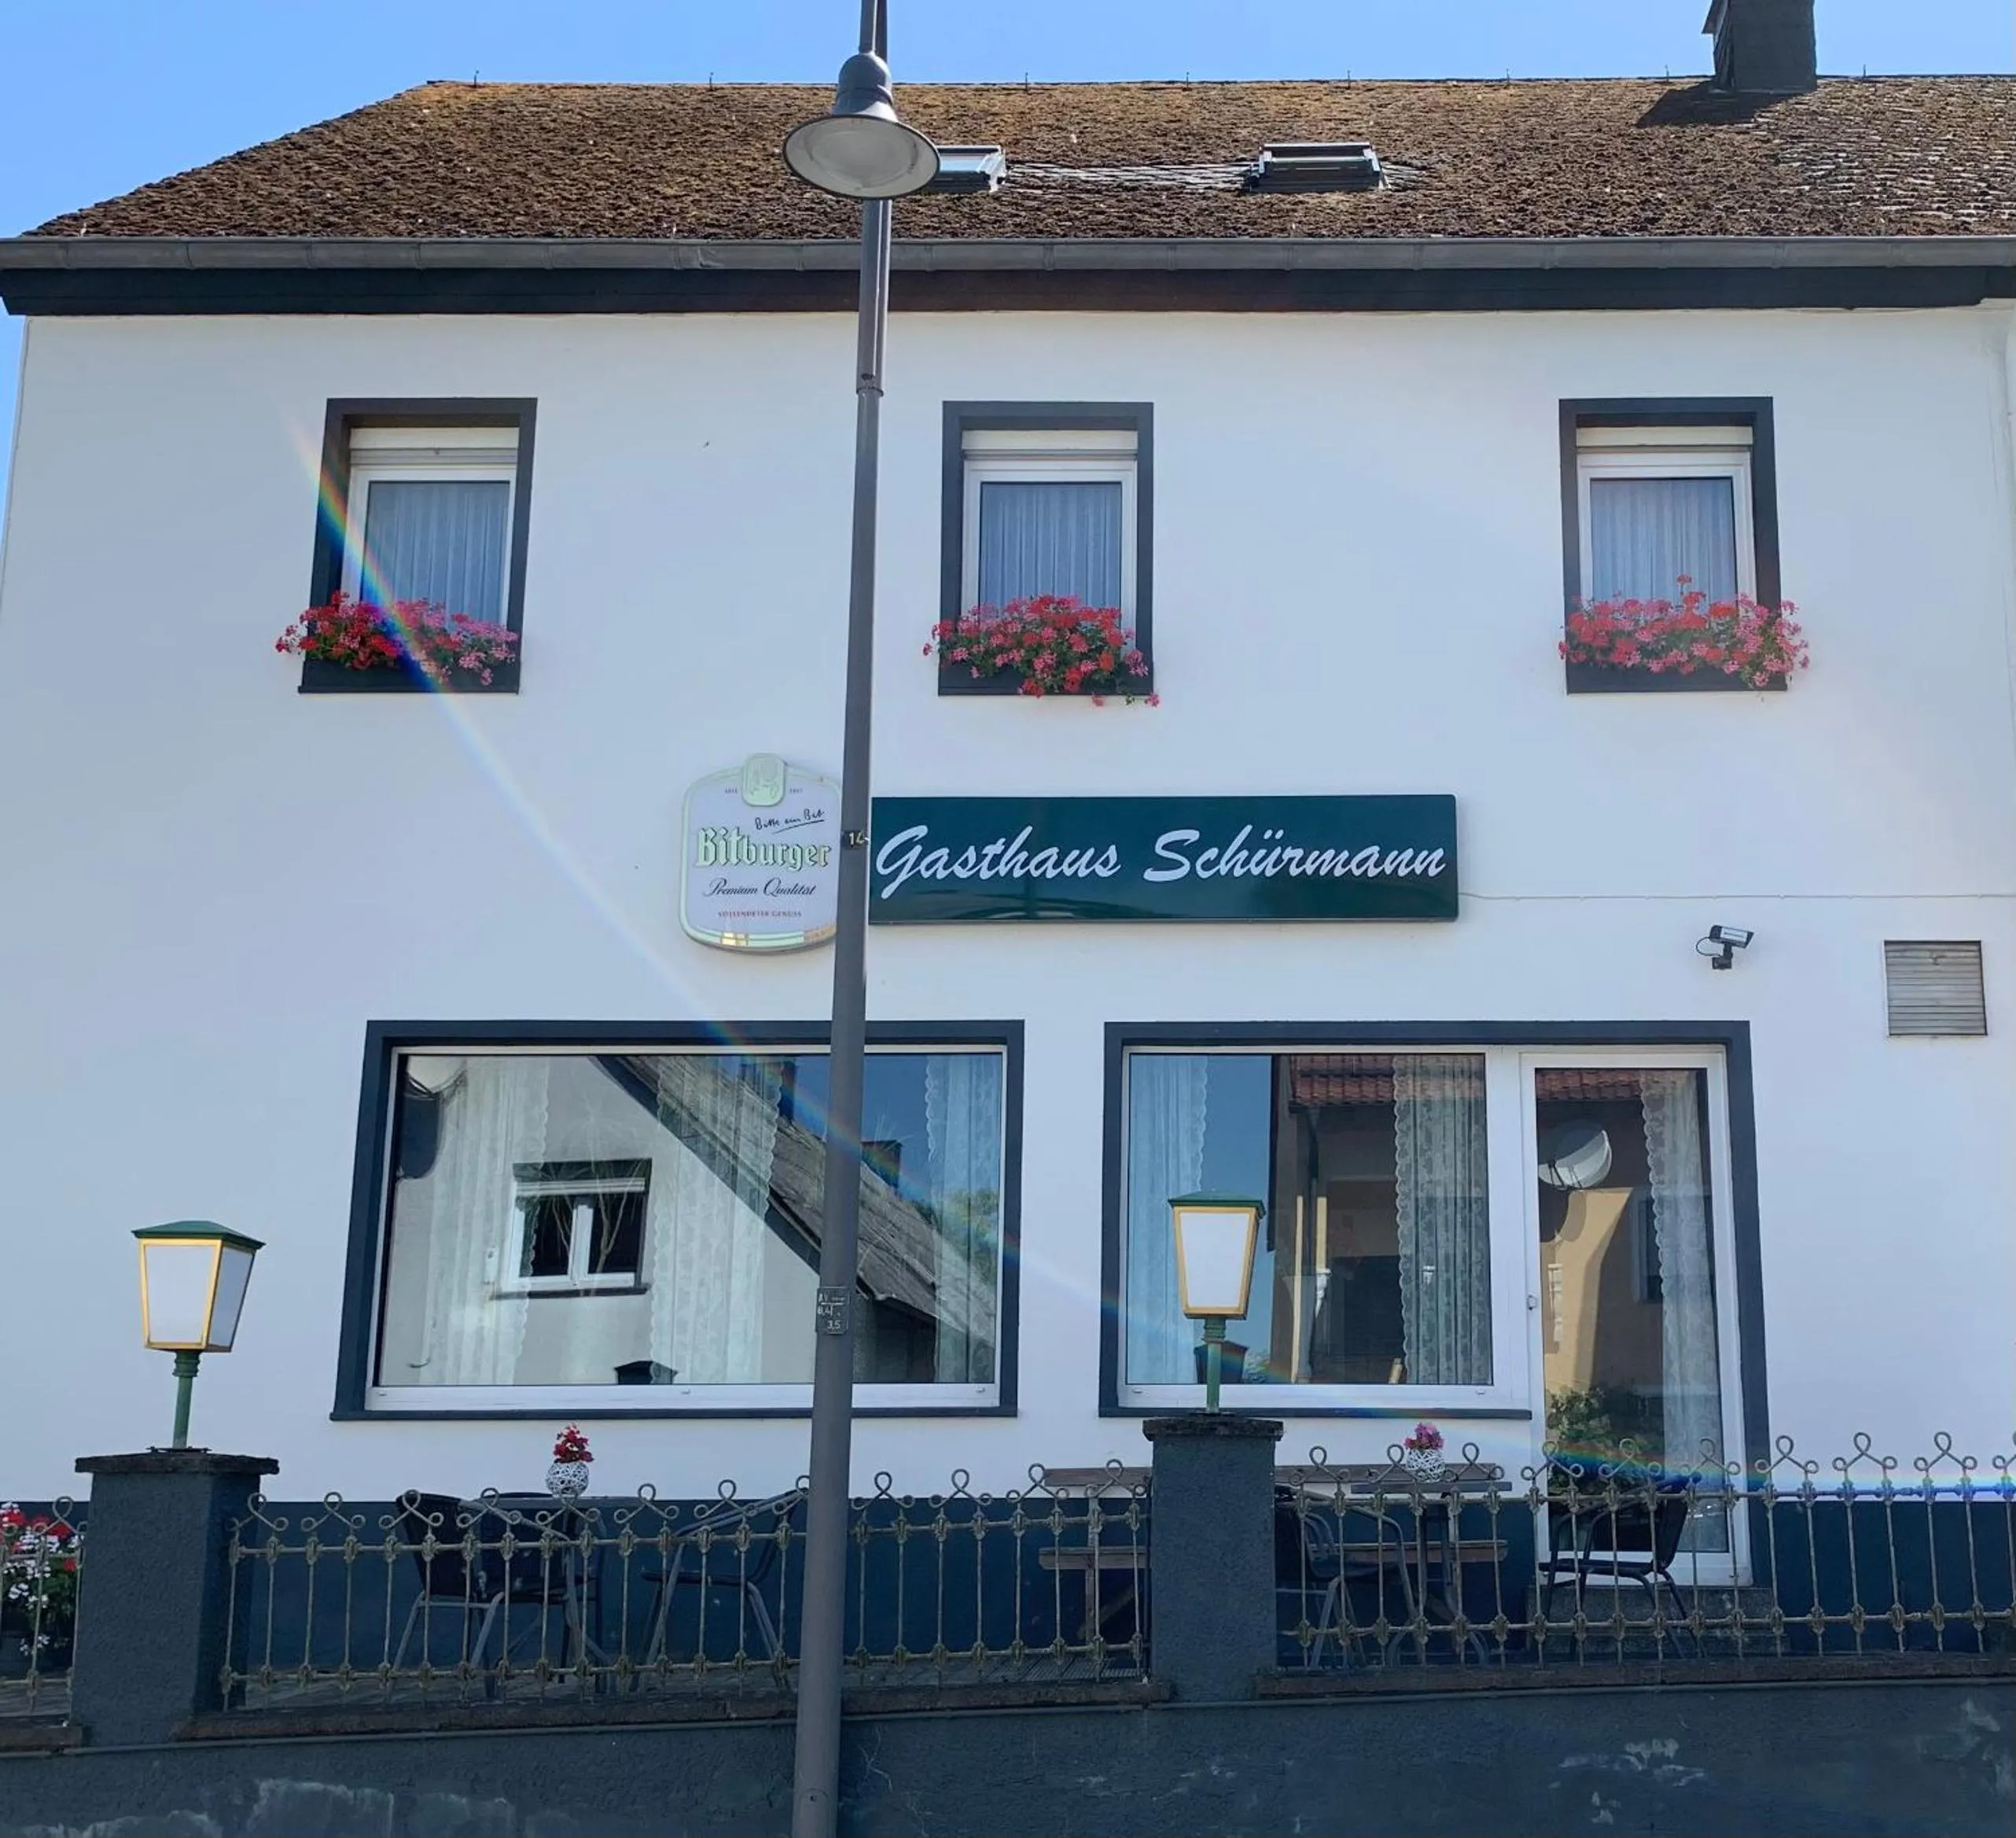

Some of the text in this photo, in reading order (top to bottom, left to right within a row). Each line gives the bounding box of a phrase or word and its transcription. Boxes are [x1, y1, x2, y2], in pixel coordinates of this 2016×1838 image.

[697, 827, 831, 871] Bitburger
[874, 825, 1446, 899] Gasthaus Schürmann
[703, 877, 816, 897] Premium Qualität
